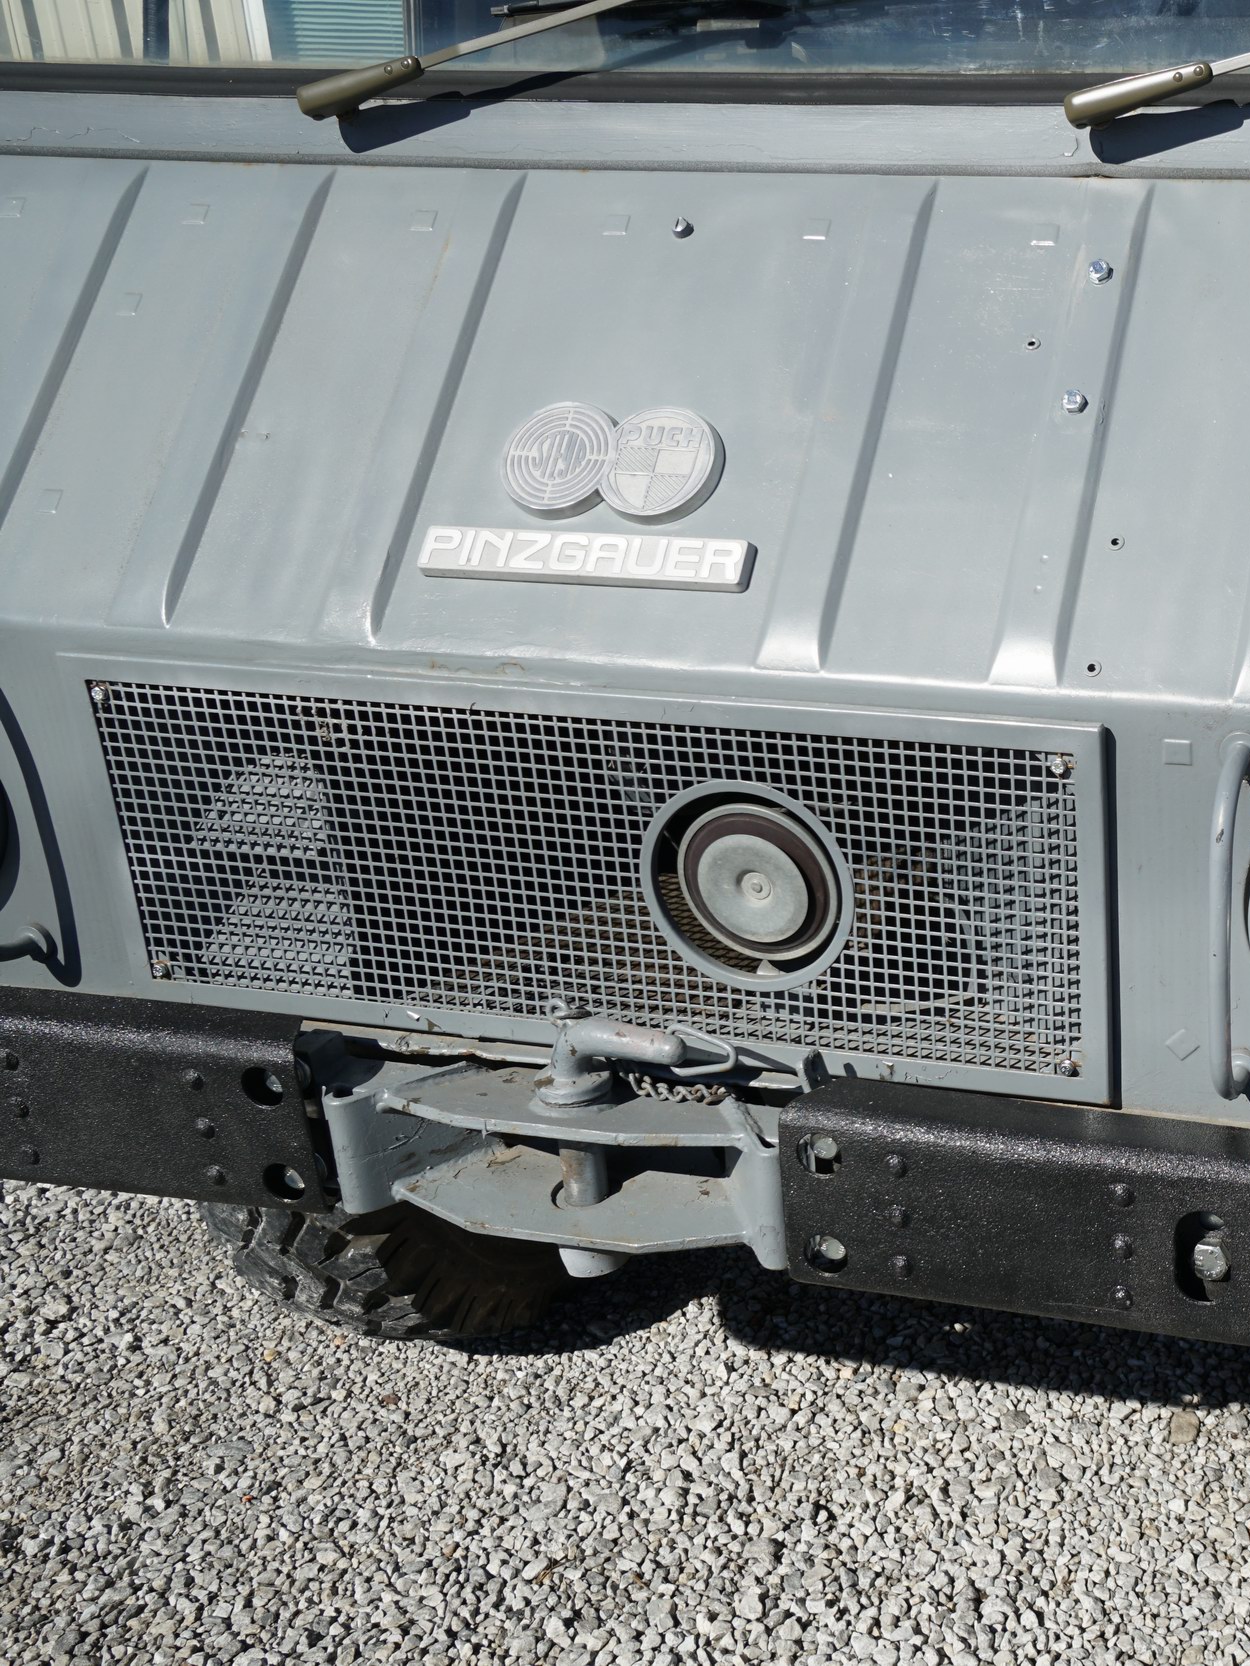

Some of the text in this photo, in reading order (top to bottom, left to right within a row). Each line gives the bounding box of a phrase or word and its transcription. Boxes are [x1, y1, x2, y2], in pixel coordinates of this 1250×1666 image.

[531, 429, 586, 482] STEYR
[618, 422, 703, 448] PUCH
[420, 528, 743, 580] PINZGAUER
